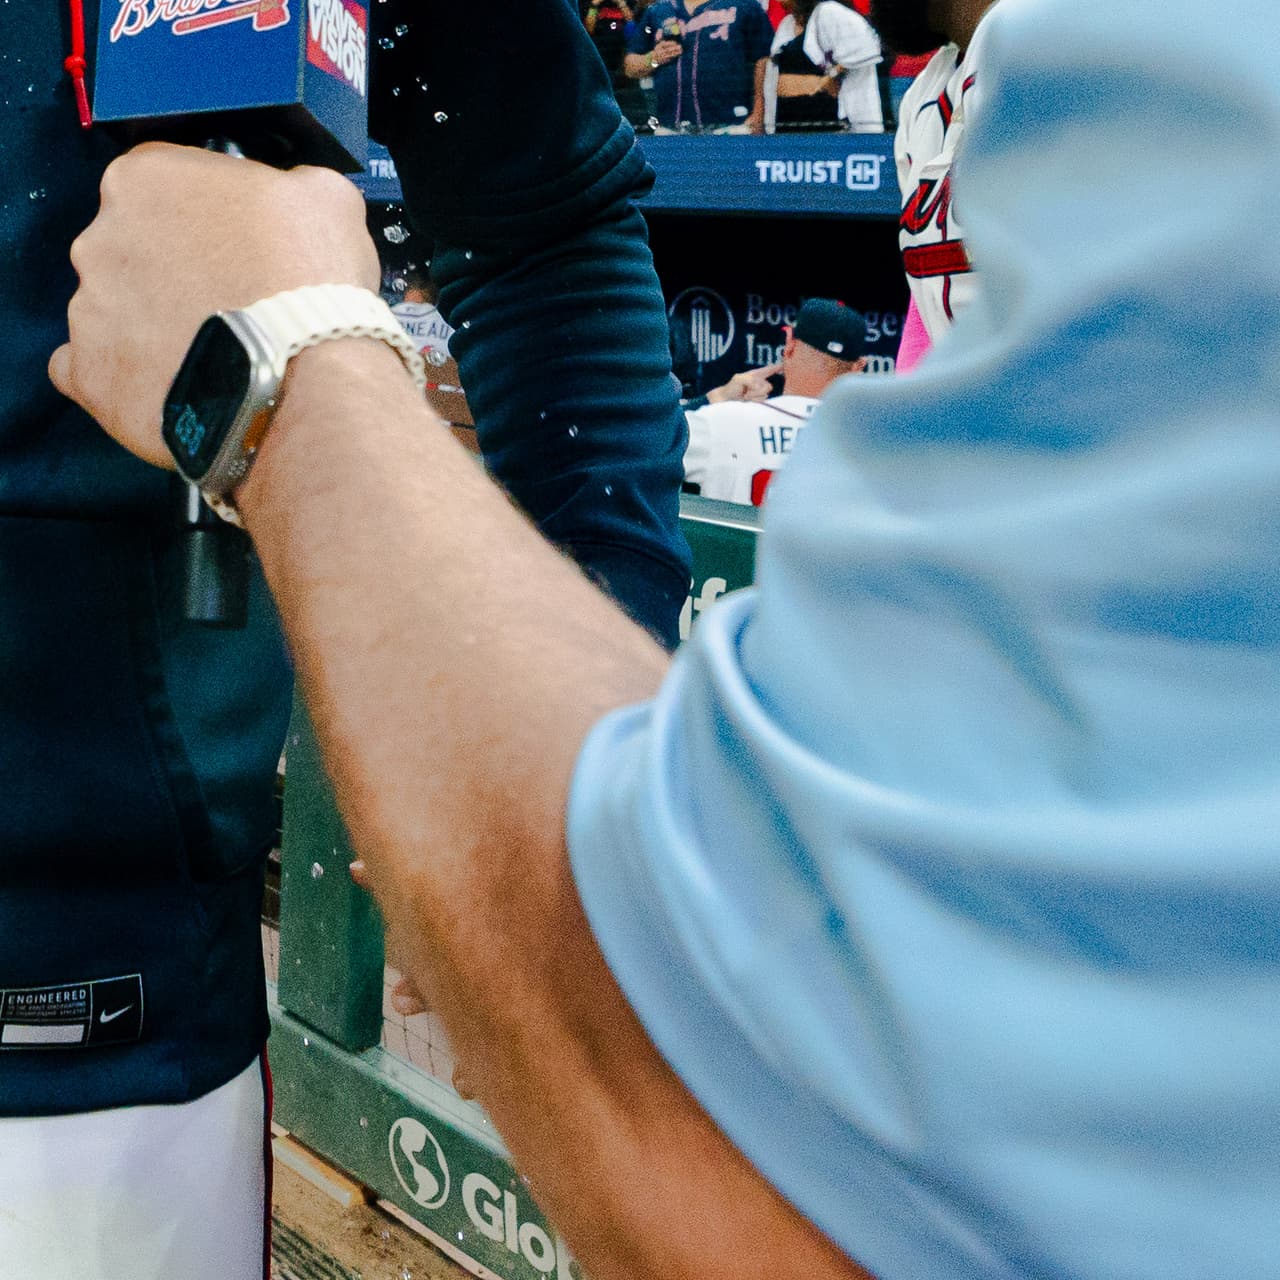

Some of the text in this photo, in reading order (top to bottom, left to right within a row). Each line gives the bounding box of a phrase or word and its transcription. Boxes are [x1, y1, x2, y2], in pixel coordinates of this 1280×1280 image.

[310, 4, 366, 98] VISION
[755, 160, 843, 183] TRUIST
[8, 989, 87, 1004] ENGINEERED
